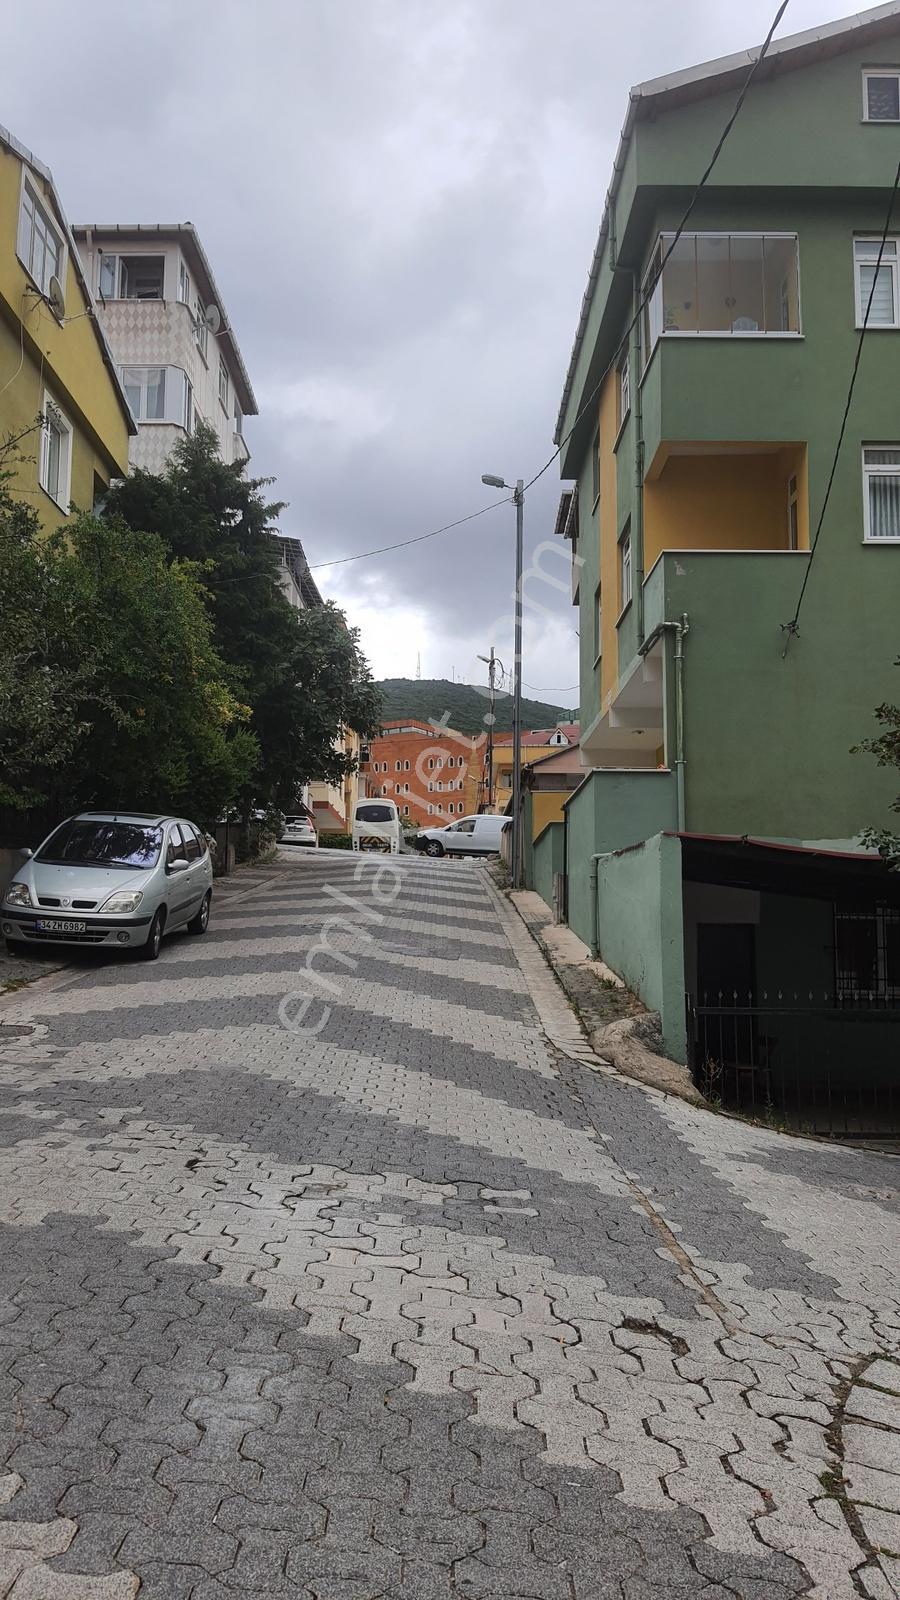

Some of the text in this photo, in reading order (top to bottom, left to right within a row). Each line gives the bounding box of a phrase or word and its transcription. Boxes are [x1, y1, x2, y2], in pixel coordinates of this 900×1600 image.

[41, 920, 85, 931] 34 ZH 6982
